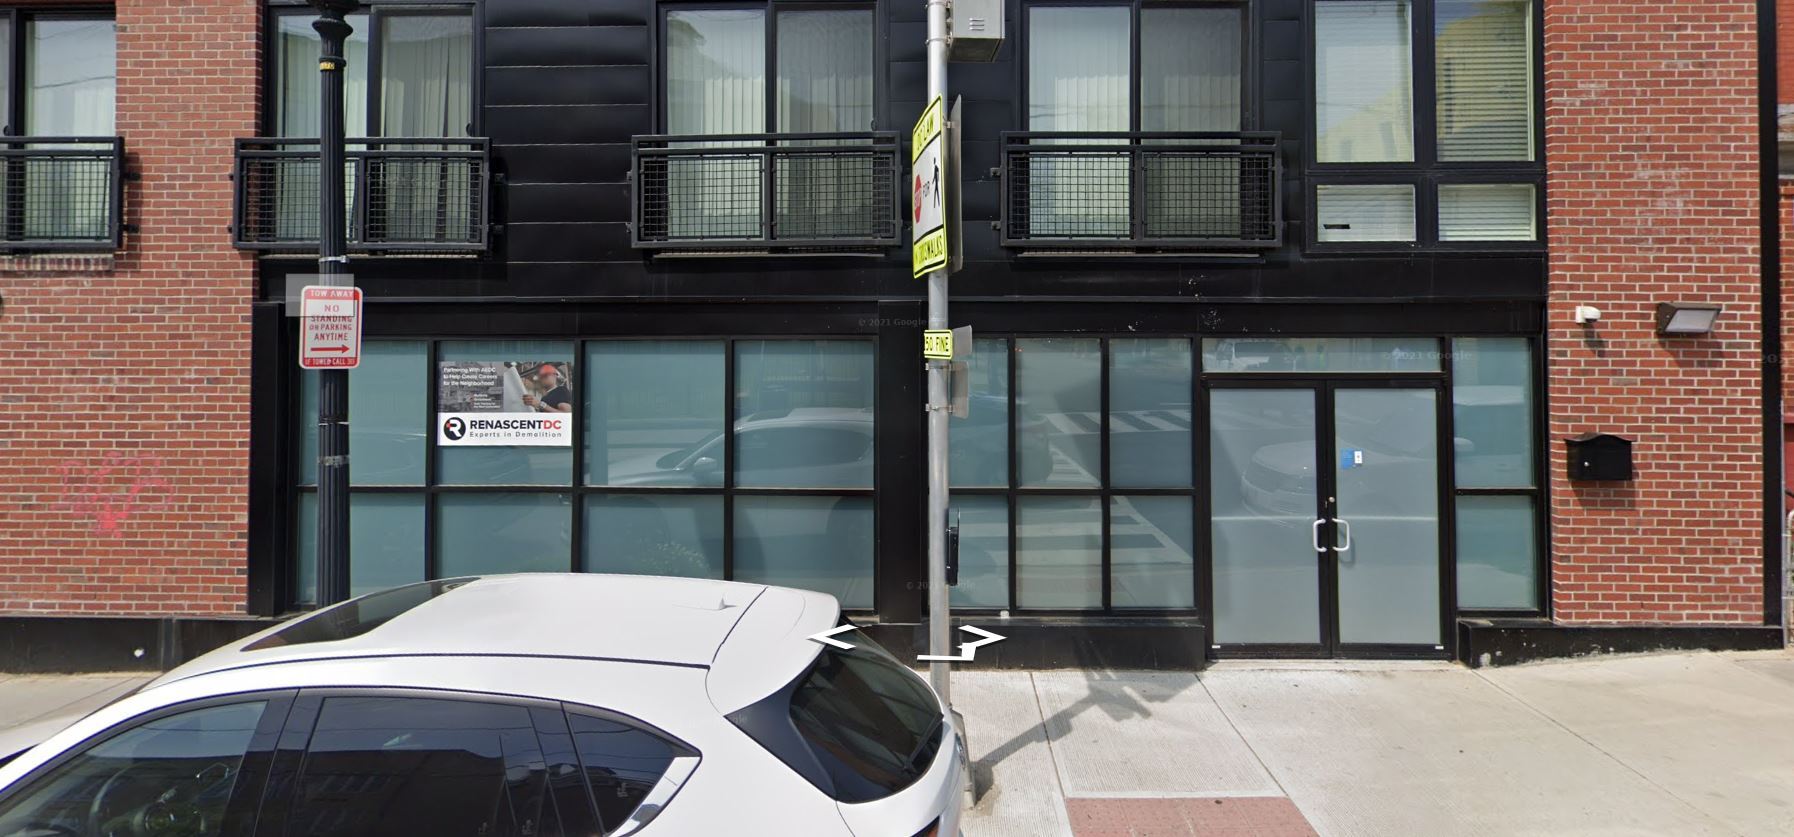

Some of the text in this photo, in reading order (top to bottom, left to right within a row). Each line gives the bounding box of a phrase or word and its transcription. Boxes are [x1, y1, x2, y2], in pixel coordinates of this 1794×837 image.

[324, 304, 339, 312] NO
[314, 333, 348, 341] ANYTIME
[935, 336, 949, 352] FINE
[470, 420, 562, 430] RENASCENTDC
[469, 431, 501, 439] Experts
